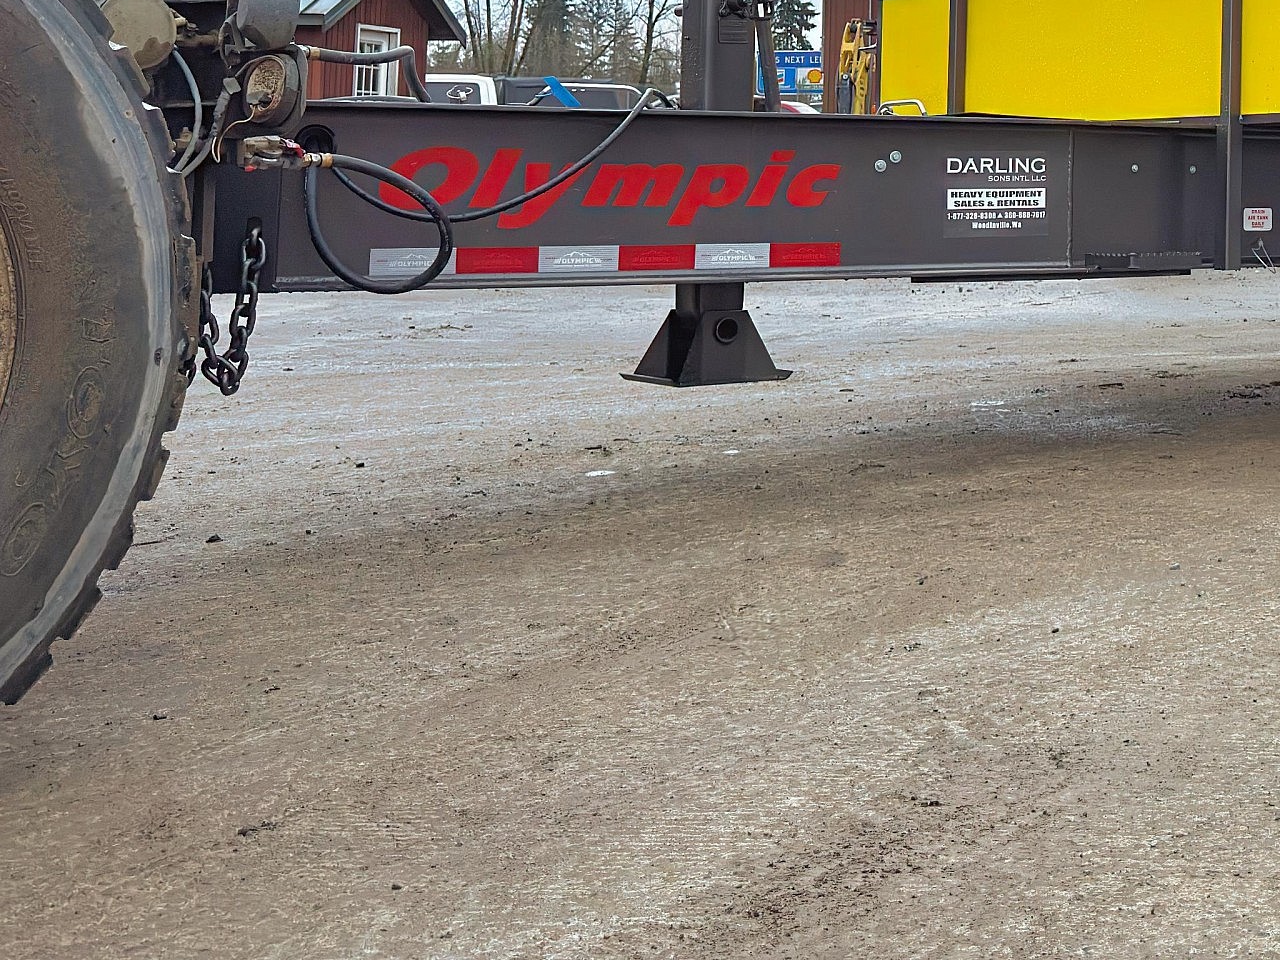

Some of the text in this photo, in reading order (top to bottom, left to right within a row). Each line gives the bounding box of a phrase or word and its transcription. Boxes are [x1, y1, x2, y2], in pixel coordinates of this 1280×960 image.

[784, 56, 805, 64] NEXT
[946, 157, 1046, 174] DARLING
[377, 145, 842, 230] Olympic
[950, 190, 1043, 199] HEAVY EQUIPMENT
[953, 200, 985, 208] SALES
